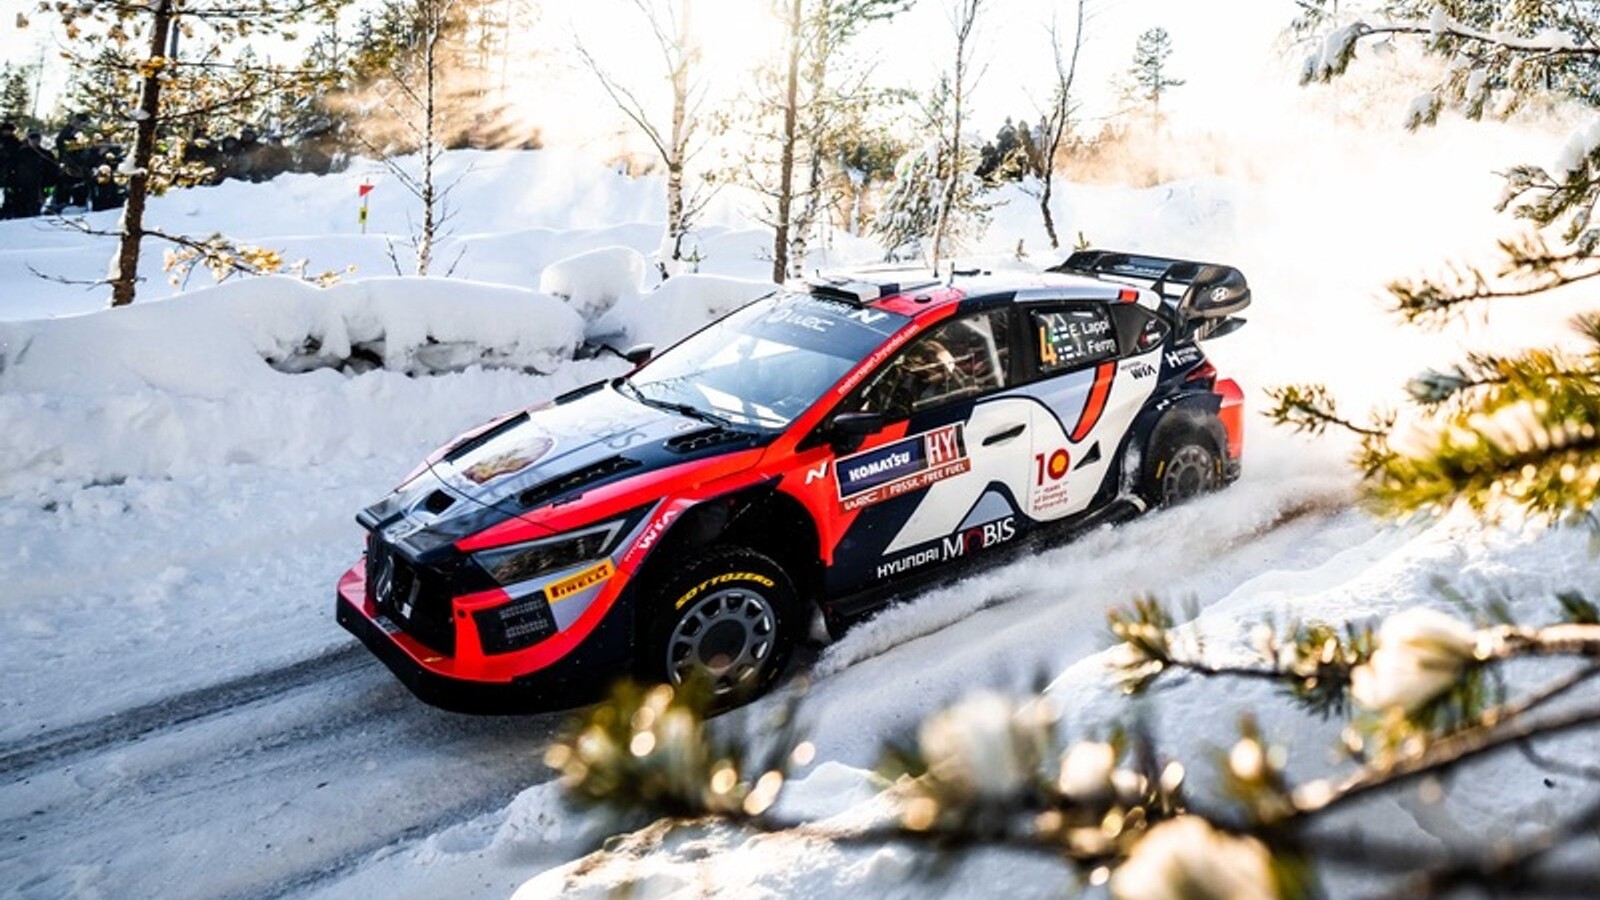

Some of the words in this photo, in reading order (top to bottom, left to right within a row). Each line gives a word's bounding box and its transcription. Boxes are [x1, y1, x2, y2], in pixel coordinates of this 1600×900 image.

[847, 309, 889, 325] N
[1039, 325, 1057, 366] 4
[1130, 364, 1157, 380] WIA
[927, 430, 957, 465] HY
[804, 461, 828, 484] N
[849, 451, 911, 482] KOMATSU
[639, 509, 678, 550] WIA
[877, 547, 940, 579] HYUNDAI
[942, 517, 1017, 562] MOBIS
[550, 563, 609, 599] PIRELLI
[674, 571, 776, 611] SOTTOZERO
